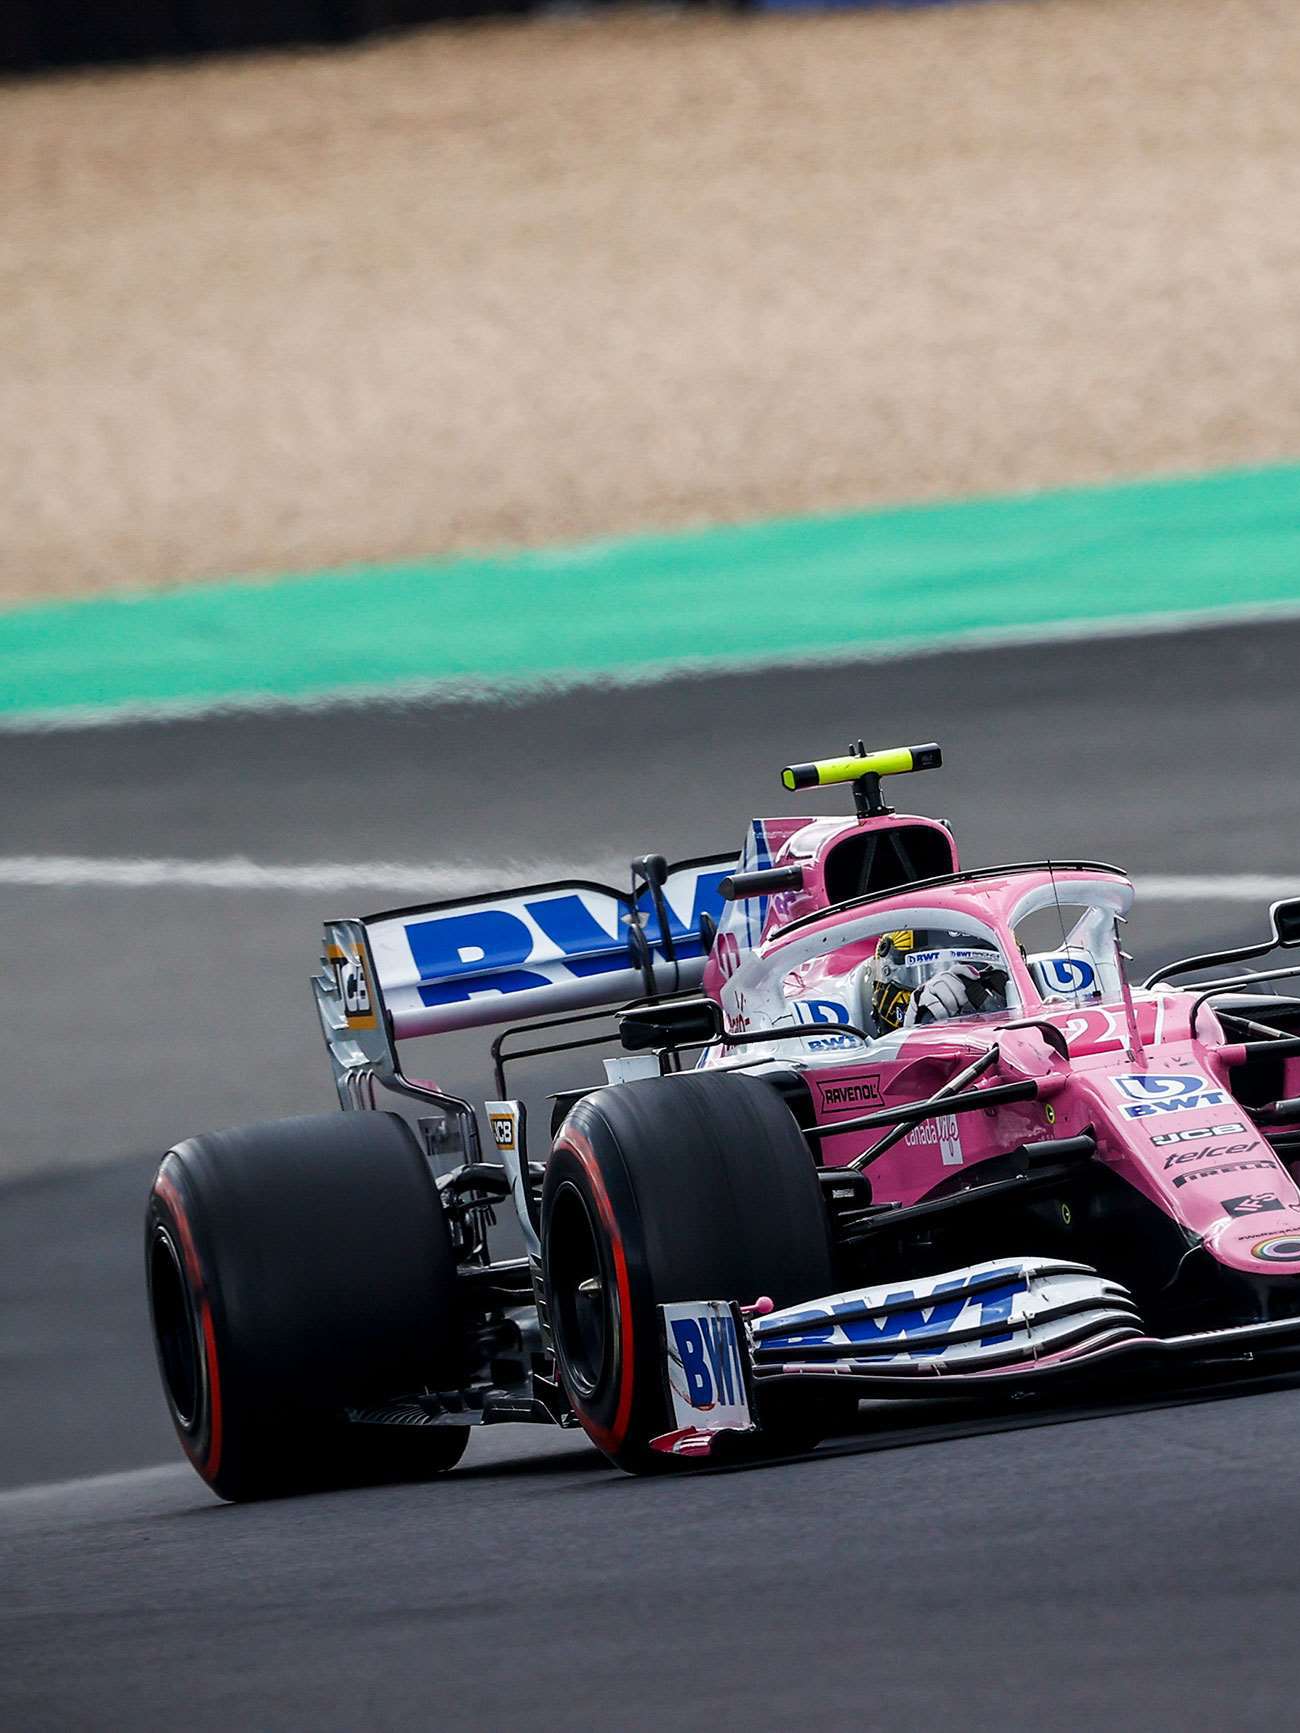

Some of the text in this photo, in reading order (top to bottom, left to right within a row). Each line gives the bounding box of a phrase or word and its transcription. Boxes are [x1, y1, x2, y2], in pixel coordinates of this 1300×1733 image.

[404, 868, 738, 1007] BW
[825, 1084, 876, 1105] RAVENOL
[1124, 1091, 1226, 1117] BWT
[1153, 1123, 1245, 1146] JCB
[1163, 1141, 1261, 1170] telcel
[1172, 1160, 1278, 1188] PIRELLI
